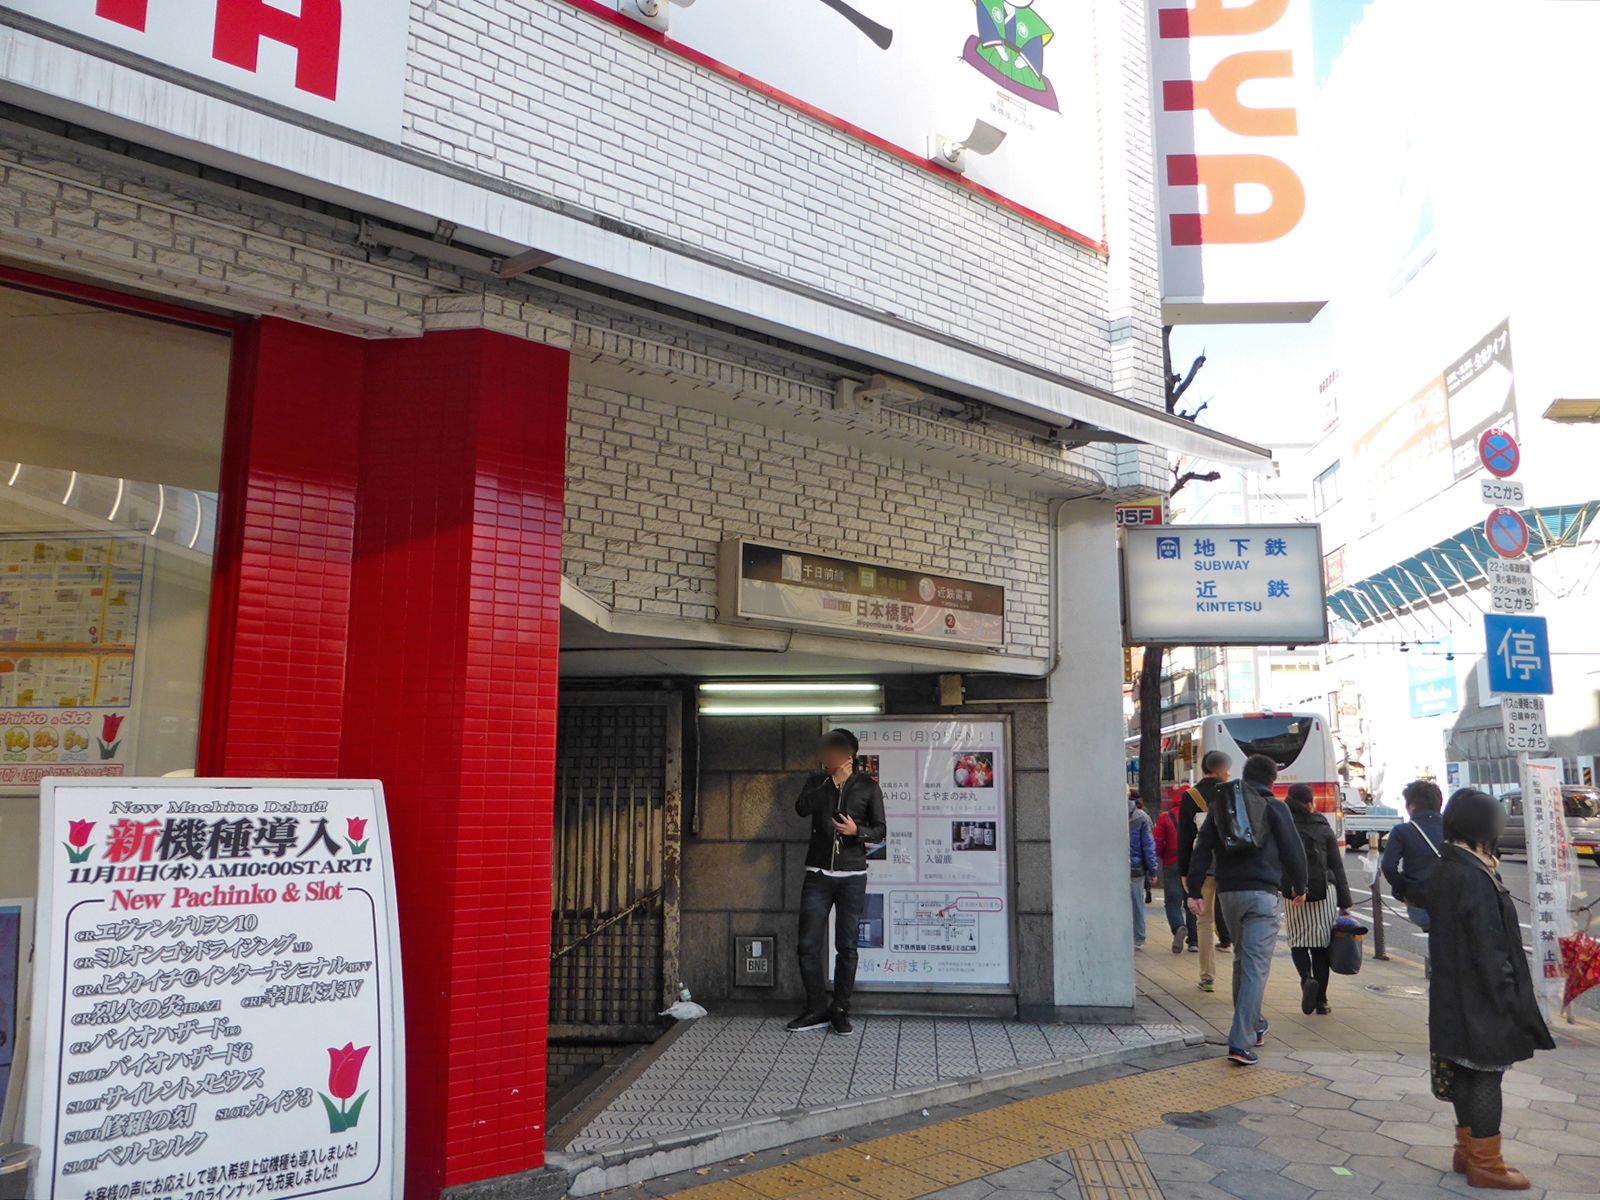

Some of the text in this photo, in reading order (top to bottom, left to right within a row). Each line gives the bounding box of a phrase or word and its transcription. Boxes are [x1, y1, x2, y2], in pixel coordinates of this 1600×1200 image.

[1482, 484, 1524, 501] ここから
[1193, 538, 1287, 557] 地下鉄
[1194, 560, 1250, 571] SUBWAY
[1196, 580, 1290, 598] 近鉄
[856, 599, 915, 623] 日本橋駅
[1196, 601, 1262, 612] KINTETSU
[1493, 597, 1534, 610] ここから
[1497, 627, 1542, 681] 停
[60, 711, 92, 724] Slot
[1507, 737, 1547, 749] ここから
[109, 801, 163, 814] New
[166, 801, 260, 814] Machine
[102, 816, 342, 863] 新機種導入
[109, 881, 343, 911] New Pachinko & Slot
[747, 958, 767, 972] BNE
